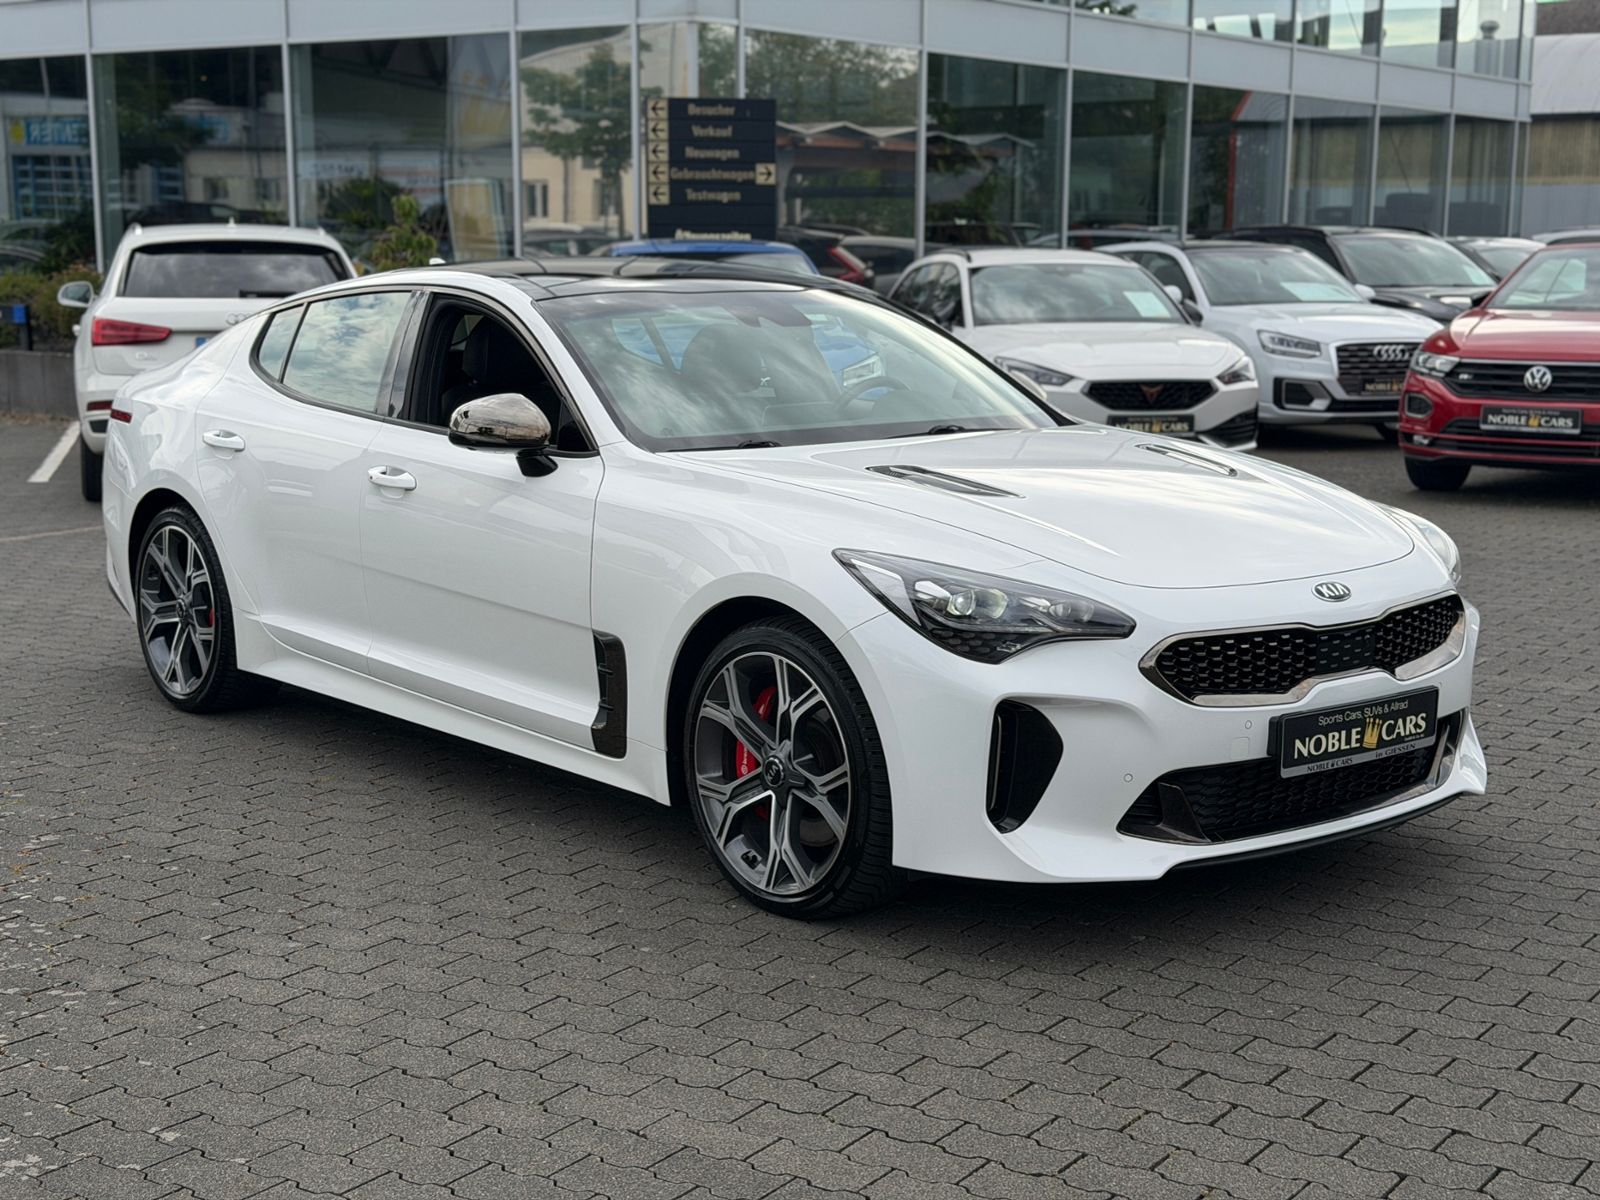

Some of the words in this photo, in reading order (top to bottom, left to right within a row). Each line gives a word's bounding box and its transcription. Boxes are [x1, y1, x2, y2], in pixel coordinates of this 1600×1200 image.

[687, 103, 736, 116] Besucher
[691, 124, 733, 138] Verkauf
[684, 146, 740, 161] Neuwagen
[670, 167, 756, 182] Gebrauchtwagen
[685, 188, 742, 203] Testwagen
[1162, 421, 1190, 432] CARS
[1487, 414, 1528, 426] NOBLE
[1540, 416, 1574, 428] CARS
[1316, 583, 1350, 598] KIA
[1318, 713, 1343, 727] Sports
[1363, 706, 1383, 718] SUVs
[1383, 704, 1389, 713] &
[1390, 700, 1409, 711] Allrad
[1294, 727, 1362, 760] NOBLE
[1381, 713, 1427, 741] CARS
[1375, 751, 1383, 759] in
[1385, 743, 1416, 756] GIESSEN
[1306, 761, 1330, 773] NOBLE
[1335, 757, 1353, 767] CARS
